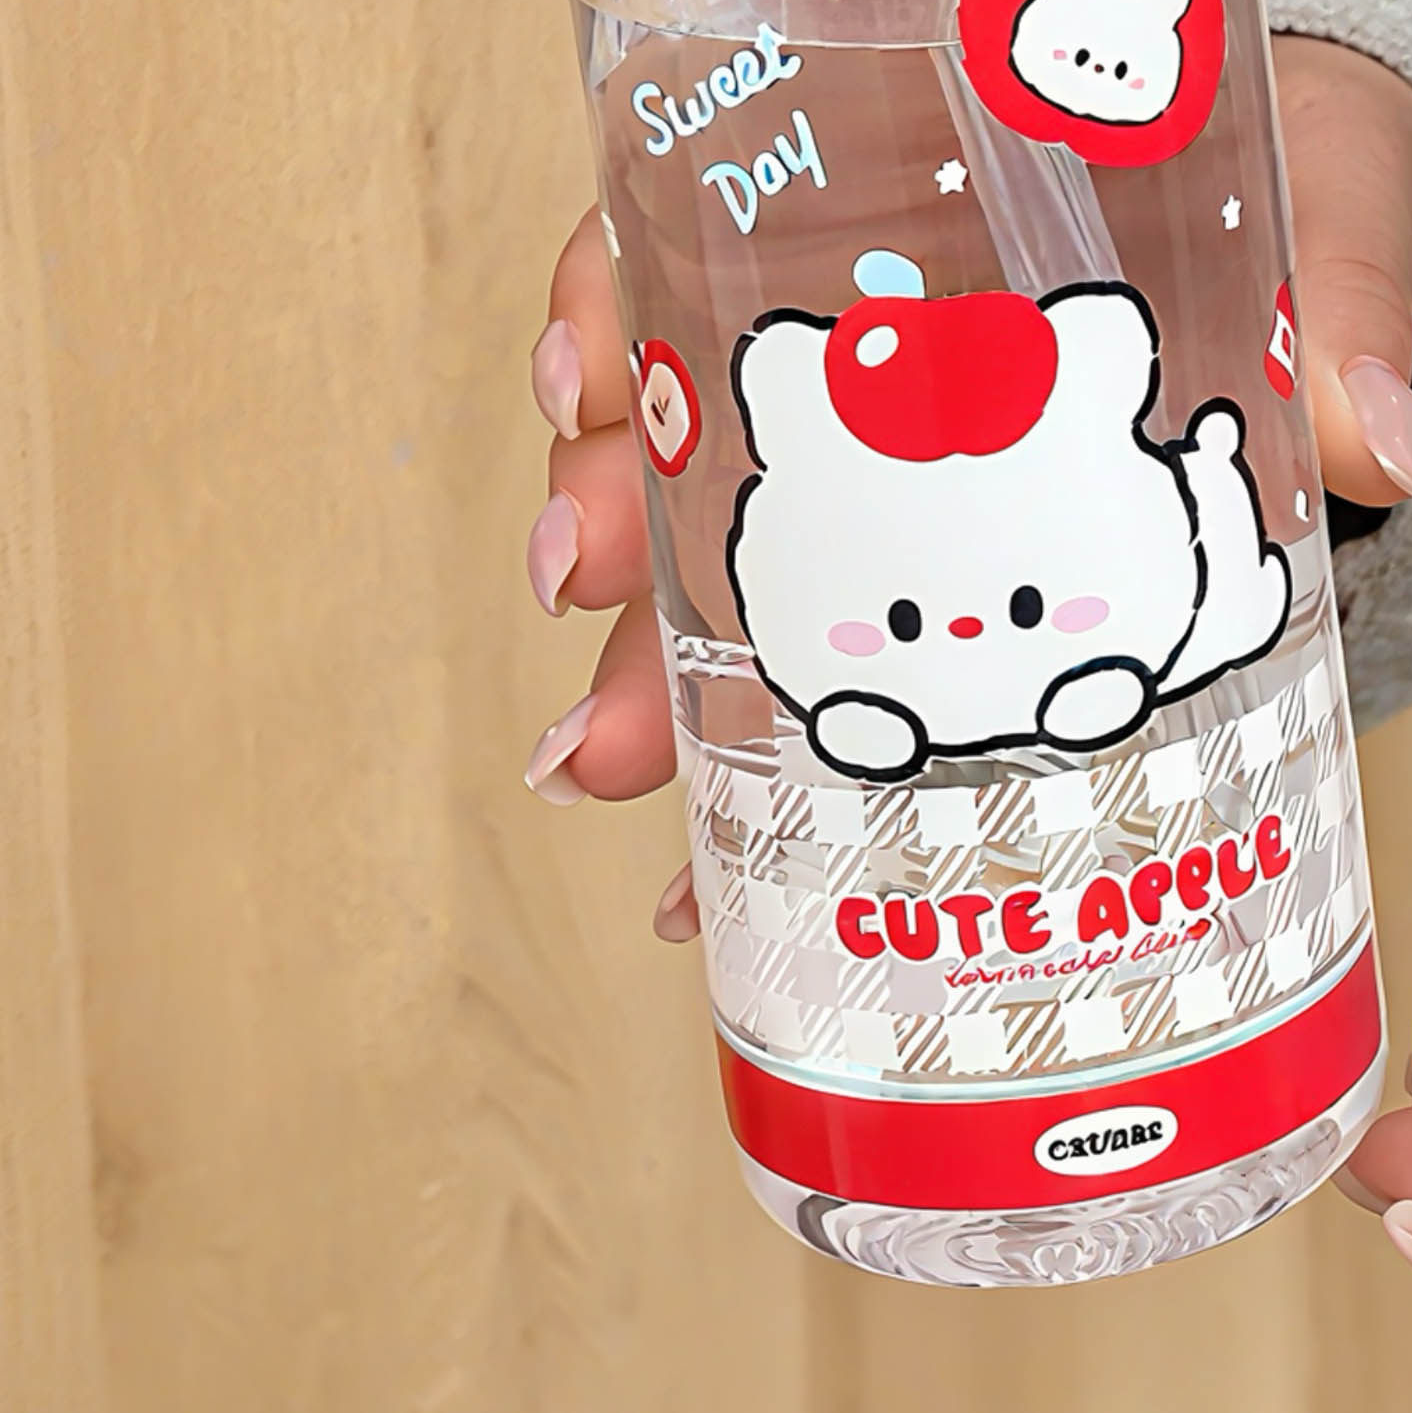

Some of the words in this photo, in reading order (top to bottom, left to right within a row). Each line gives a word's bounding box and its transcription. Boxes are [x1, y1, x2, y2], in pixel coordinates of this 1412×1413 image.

[631, 21, 803, 157] Sweet
[835, 889, 1052, 961] CUTE
[1077, 813, 1292, 943] APPLE
